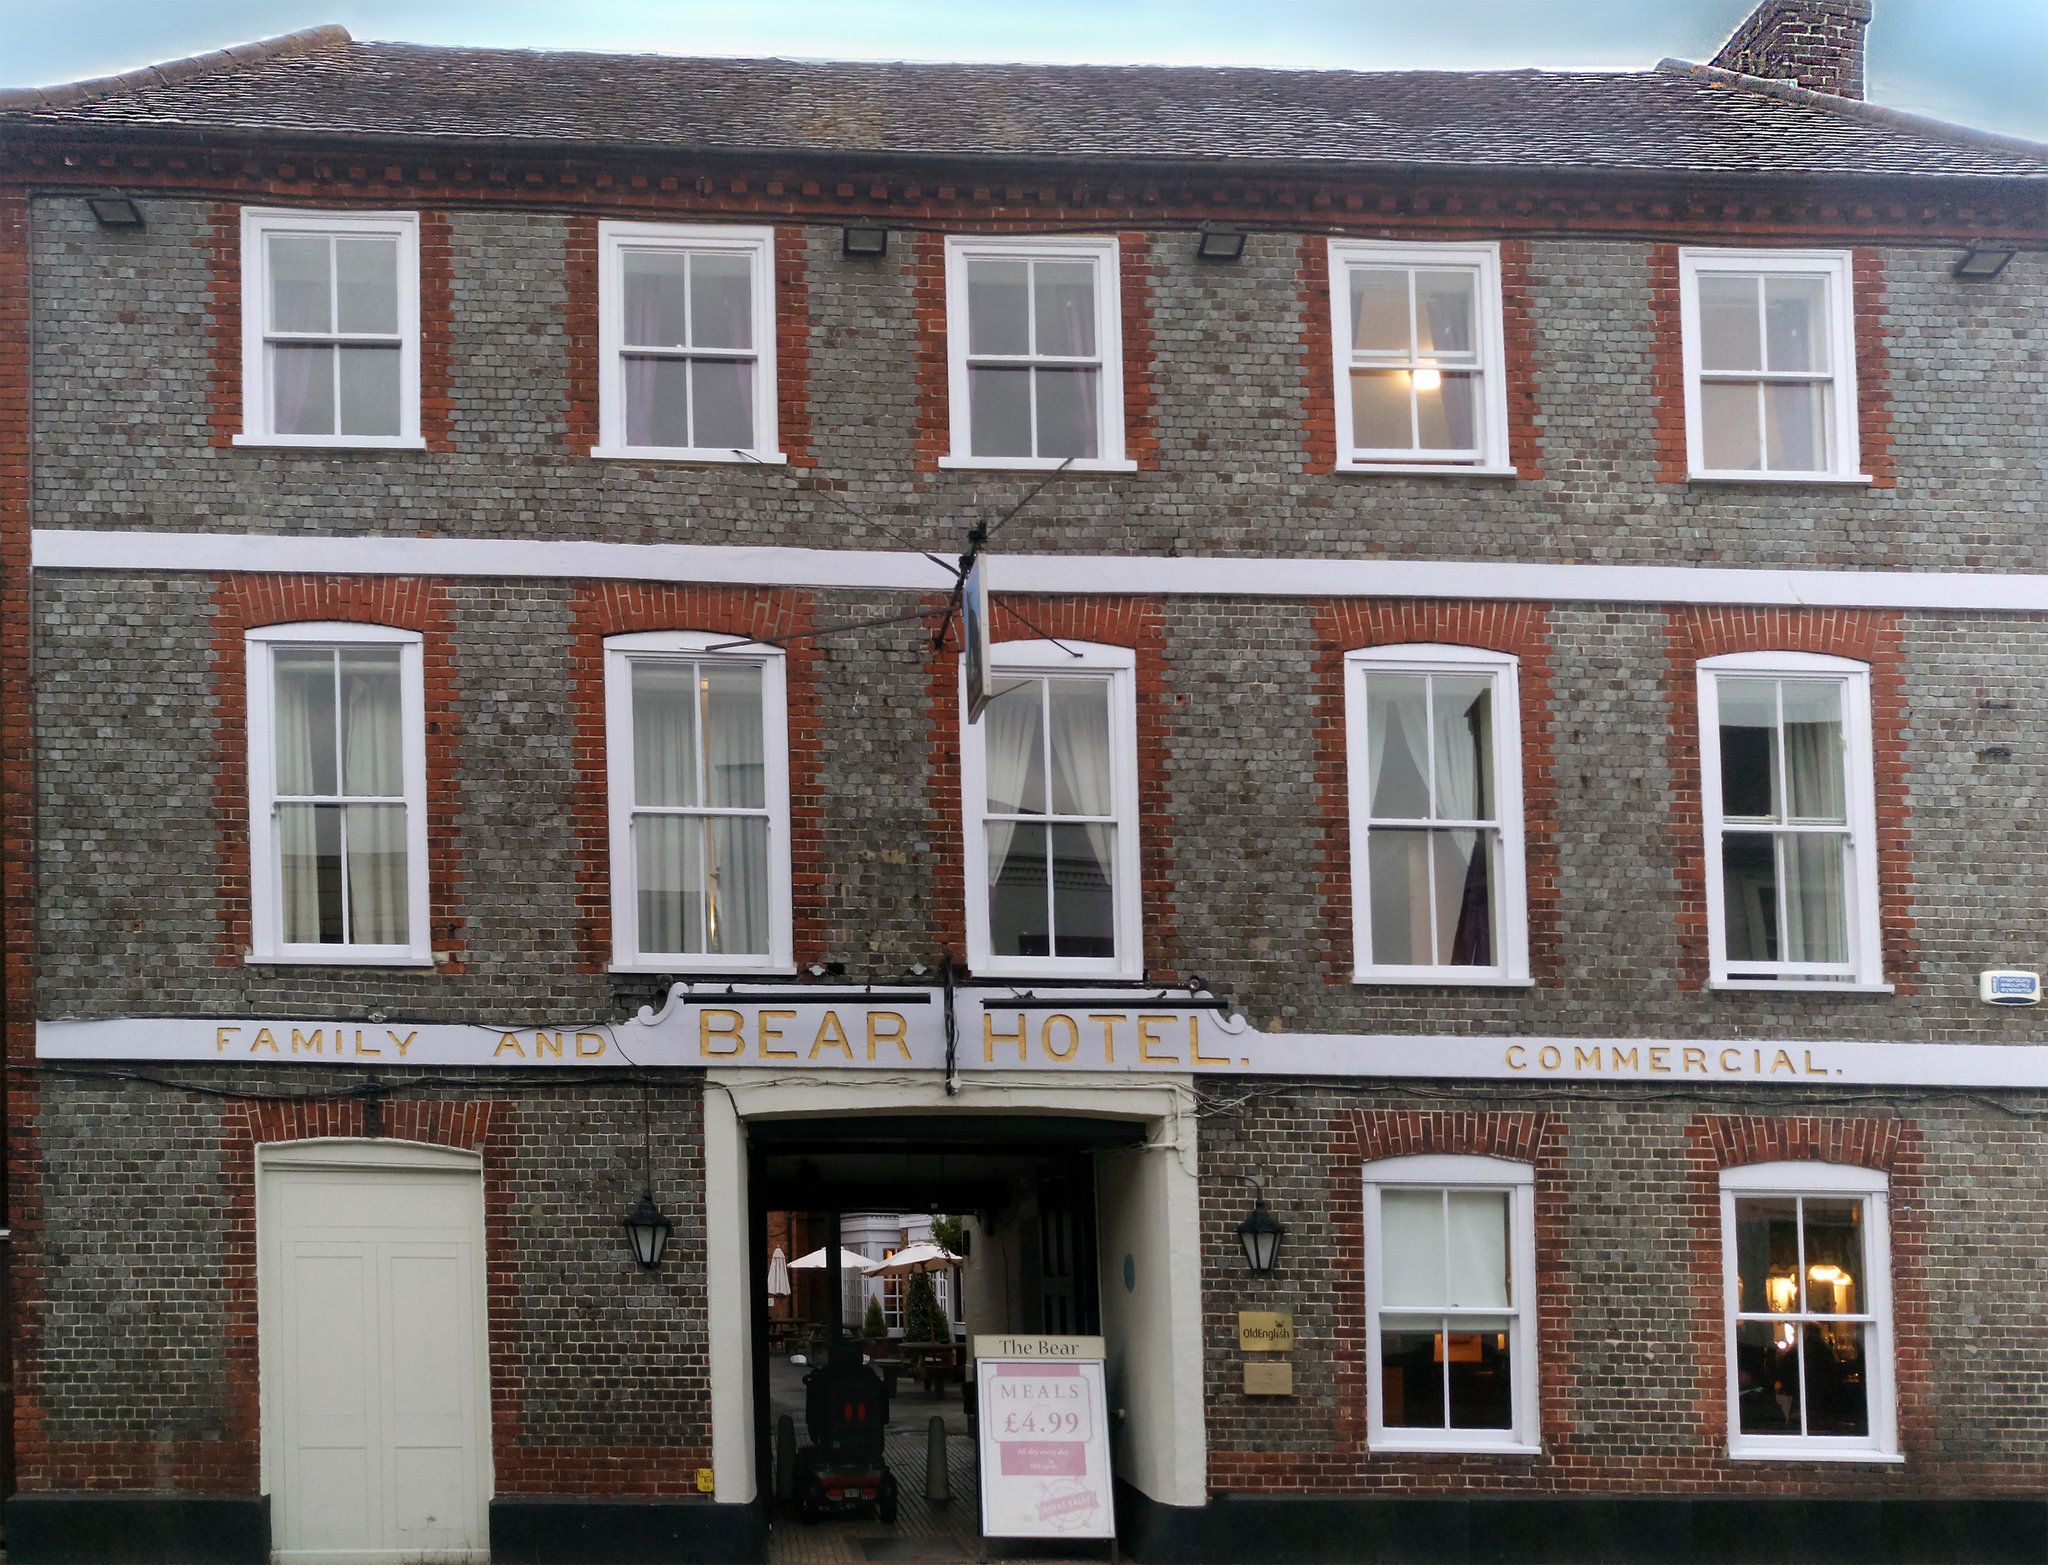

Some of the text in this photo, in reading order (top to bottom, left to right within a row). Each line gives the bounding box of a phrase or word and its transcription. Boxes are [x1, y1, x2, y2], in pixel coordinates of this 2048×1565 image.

[216, 1027, 607, 1058] FAMILY AND
[699, 1008, 912, 1061] BEAR
[999, 1339, 1080, 1356] The Bear
[1001, 1384, 1080, 1399] MEALS
[1004, 1411, 1080, 1434] £4.99
